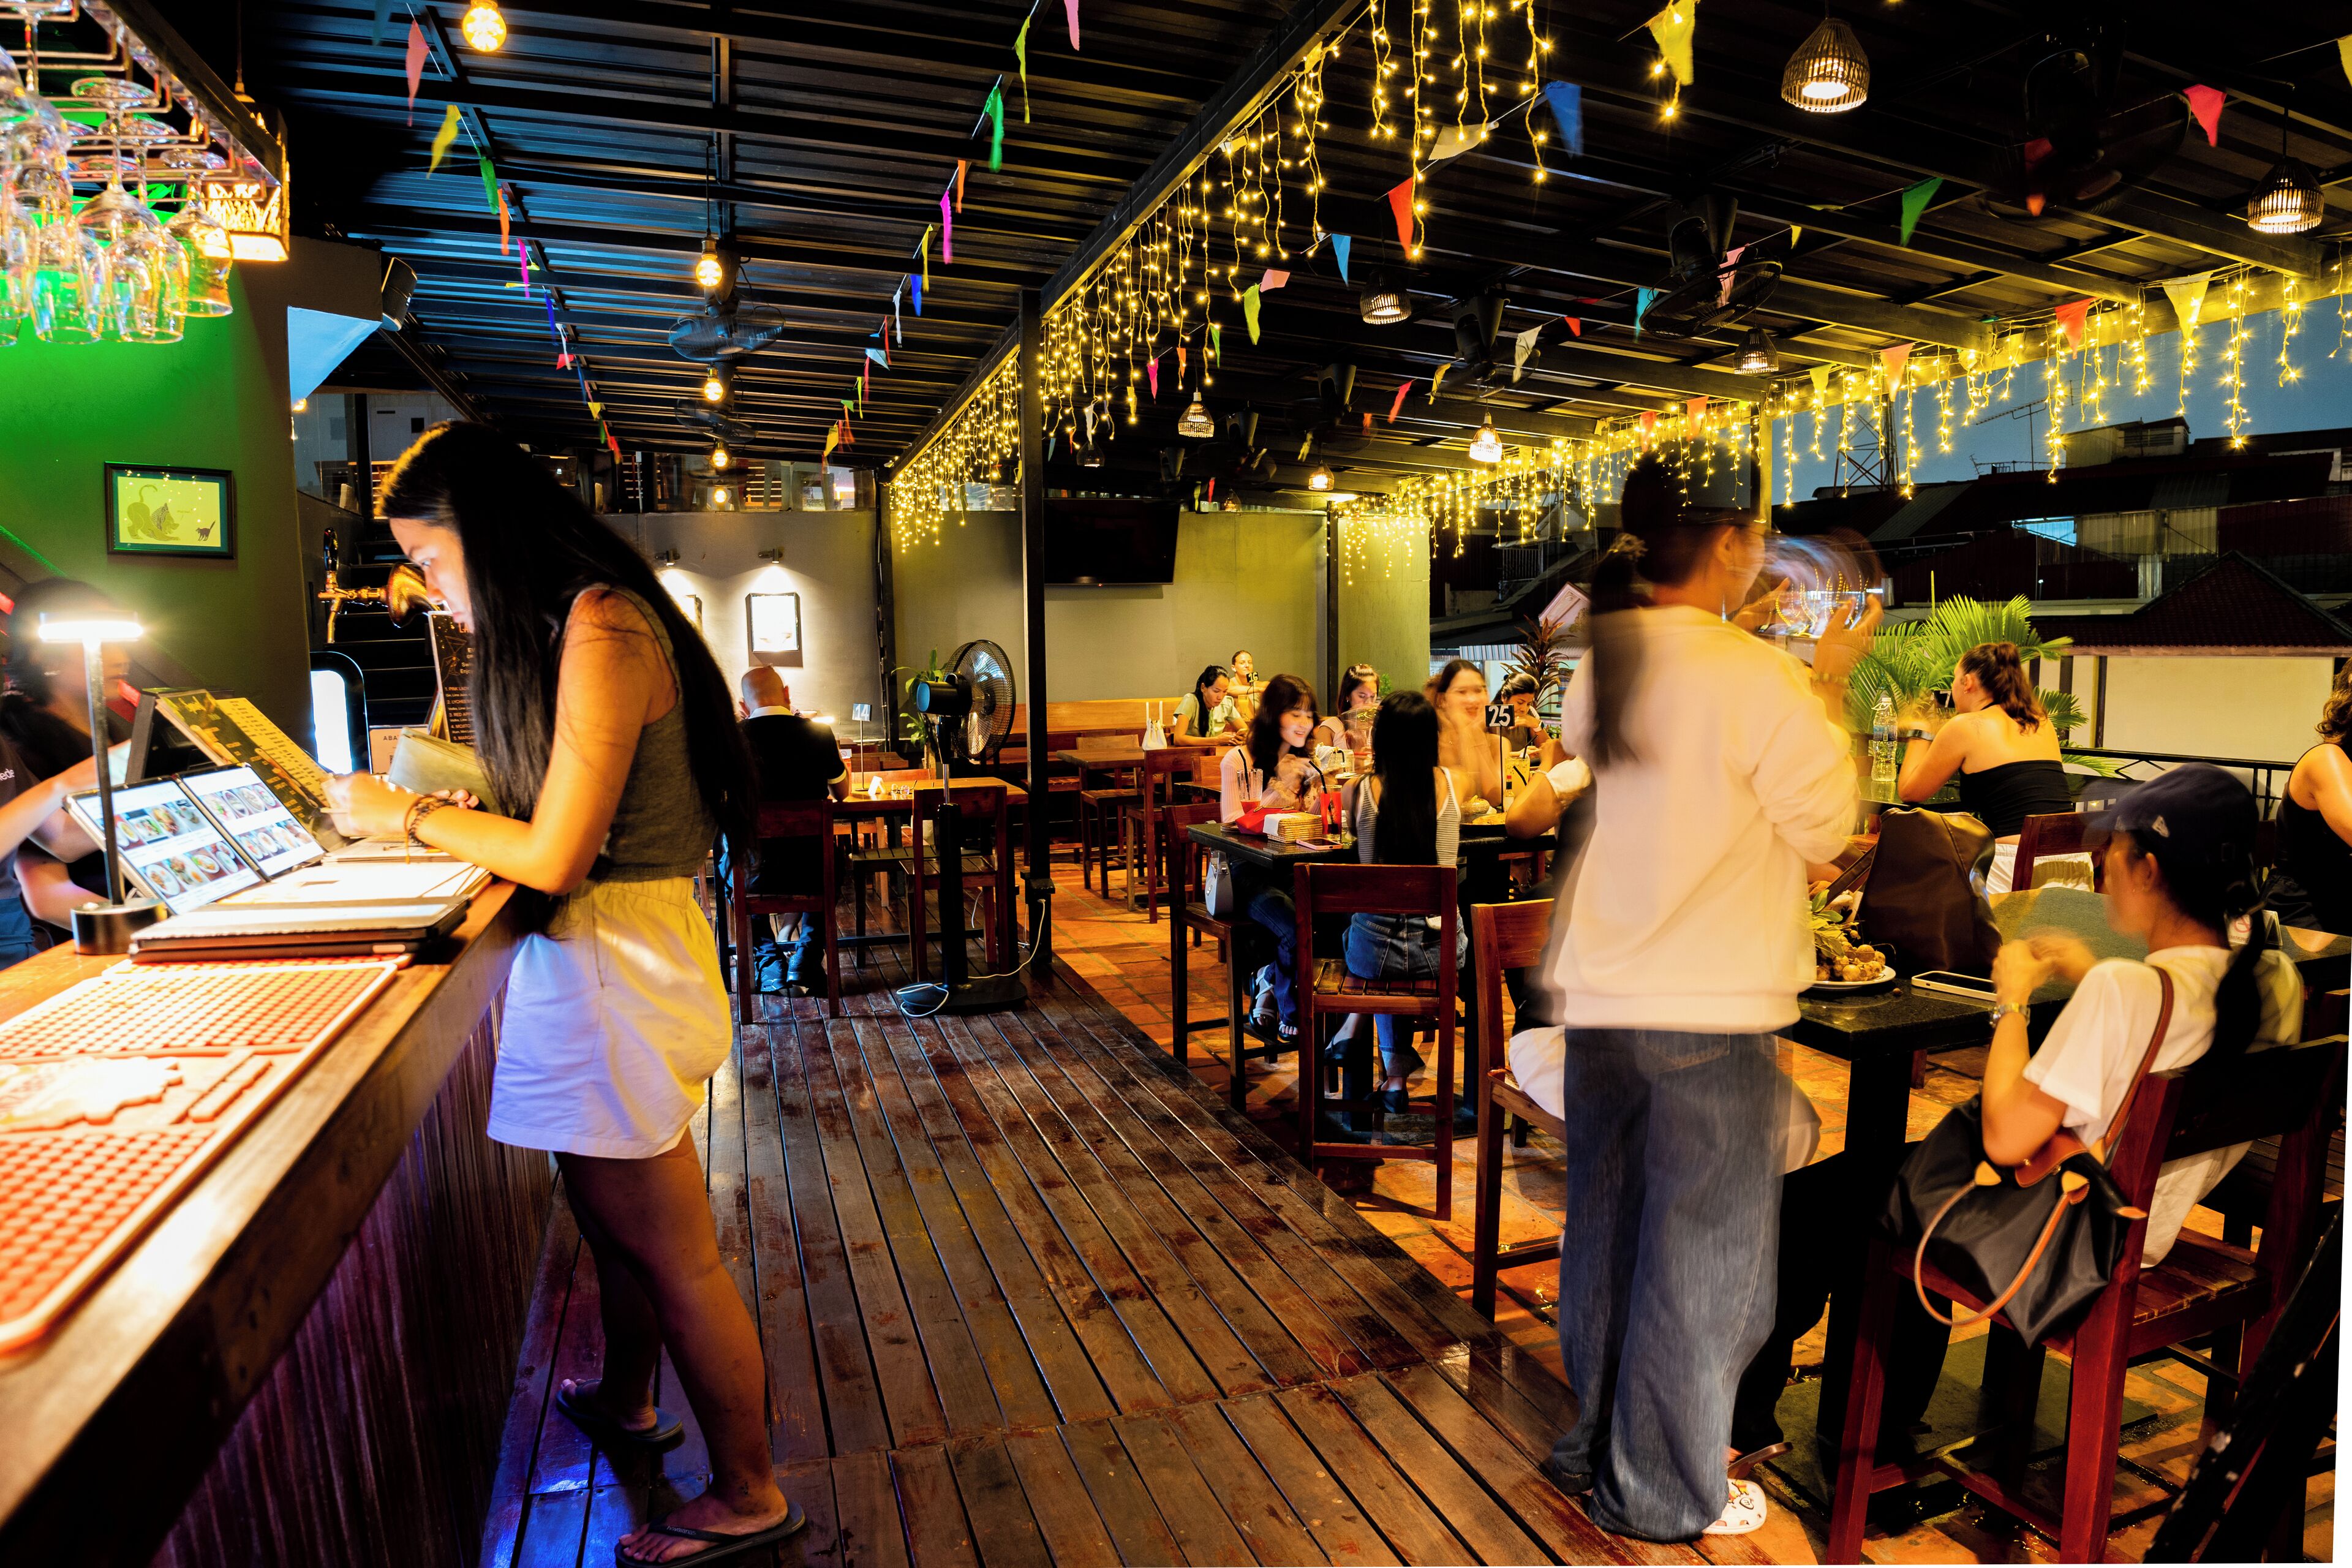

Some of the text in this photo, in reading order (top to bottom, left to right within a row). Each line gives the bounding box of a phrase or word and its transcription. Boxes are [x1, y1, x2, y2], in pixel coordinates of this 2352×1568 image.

[1248, 672, 1258, 683] 16
[856, 704, 869, 721] 14
[1488, 705, 1510, 727] 25
